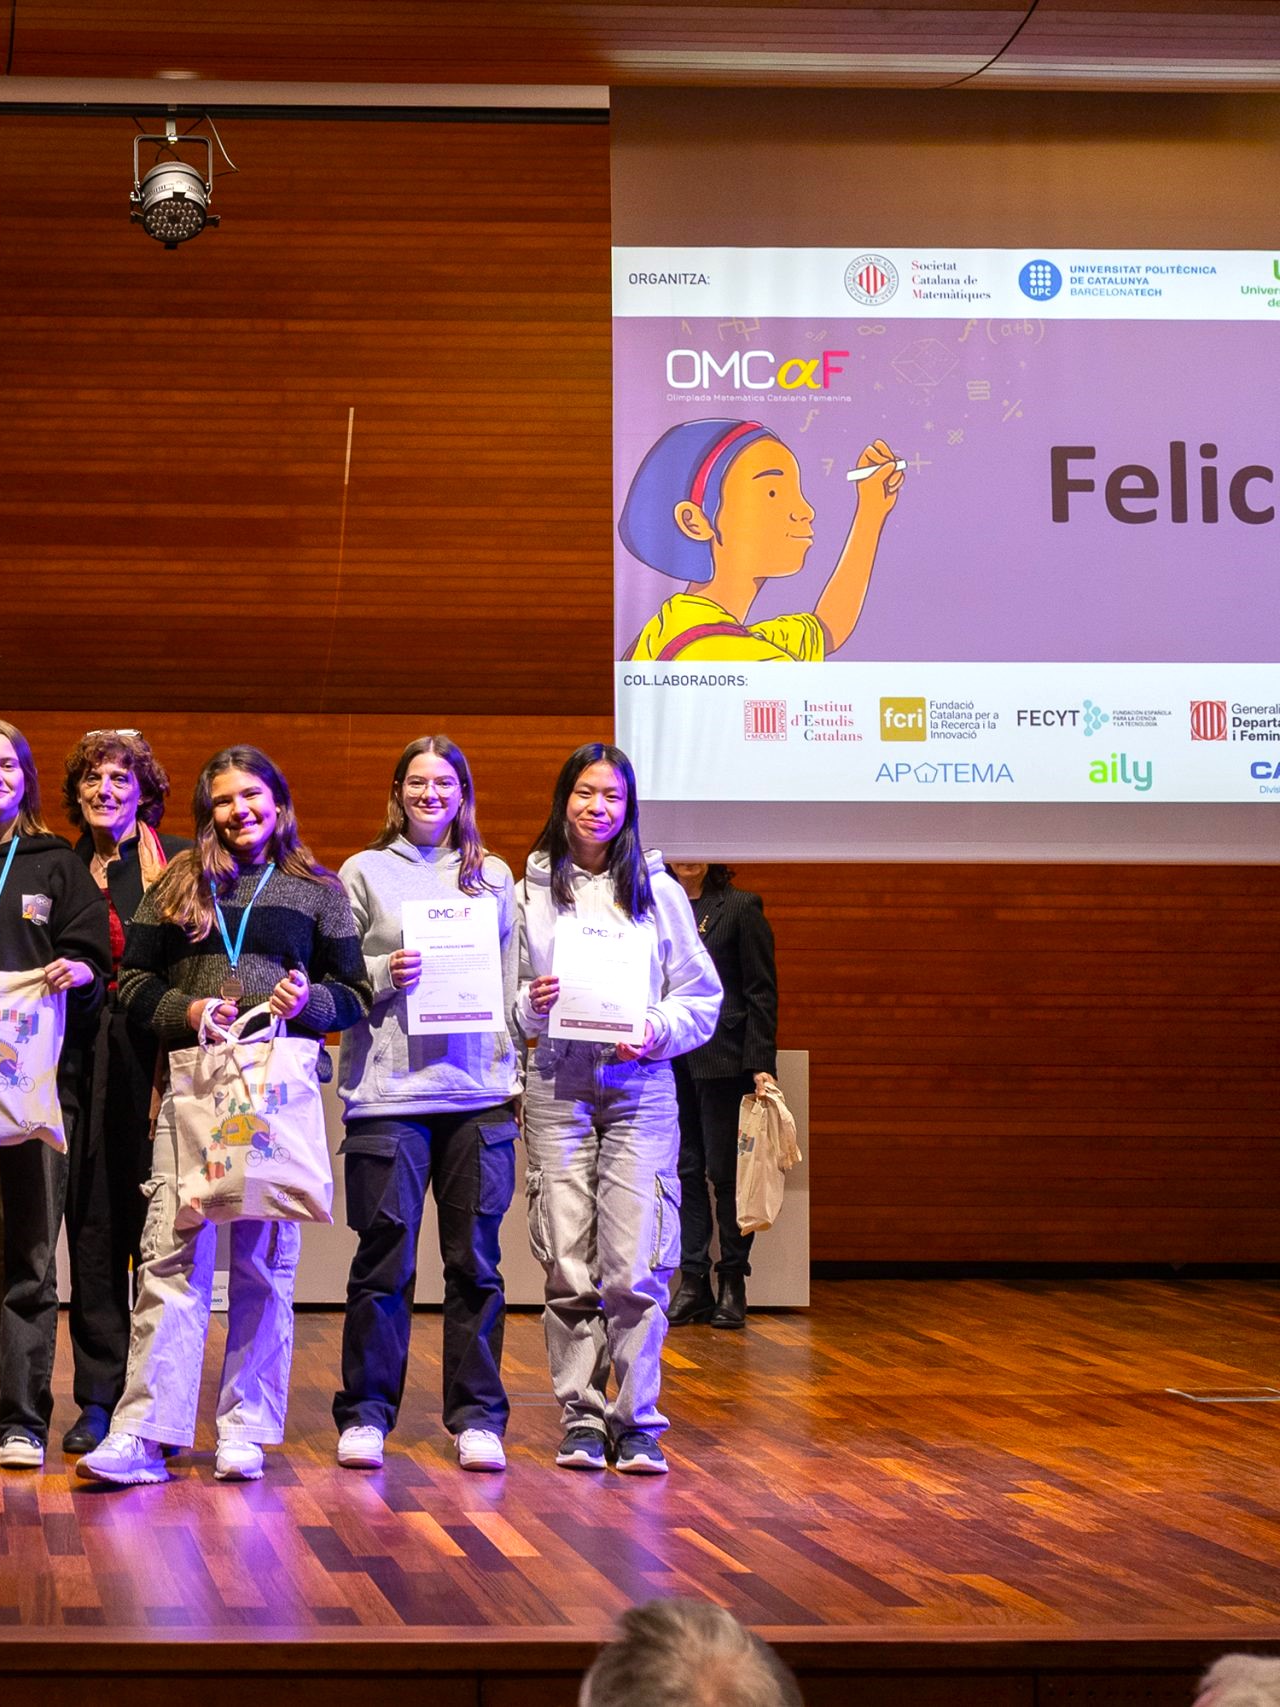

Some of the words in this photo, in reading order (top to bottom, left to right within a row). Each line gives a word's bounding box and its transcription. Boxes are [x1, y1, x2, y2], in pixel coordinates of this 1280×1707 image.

[911, 260, 957, 271] Societat
[1069, 265, 1142, 274] UNIVERSITAT
[1145, 264, 1217, 275] POLITÈCNICA
[628, 272, 711, 286] ORGANITZA:
[912, 274, 961, 285] Catalana
[963, 274, 978, 285] de
[1070, 276, 1085, 285] DE
[1087, 276, 1150, 285] CATALUNYA
[912, 288, 991, 303] Matemàtiques
[1029, 287, 1051, 297] UPC
[1070, 287, 1163, 297] BARCELONATECH
[767, 393, 807, 402] Catalana
[808, 393, 852, 402] Femenina
[1050, 440, 1275, 525] Felic
[803, 699, 853, 712] Institut
[929, 700, 974, 710] Fundació
[790, 714, 854, 727] d'Estudis
[883, 707, 923, 729] fcri
[929, 710, 973, 720] Catalana
[974, 712, 991, 721] per
[993, 712, 1000, 720] a
[1016, 709, 1080, 727] FECYT
[930, 720, 939, 729] la
[941, 720, 980, 729] Recerca
[987, 720, 997, 729] la
[803, 729, 863, 741] Catalans
[930, 730, 977, 739] Innovació
[1232, 730, 1236, 741] i
[1088, 752, 1153, 792] aily
